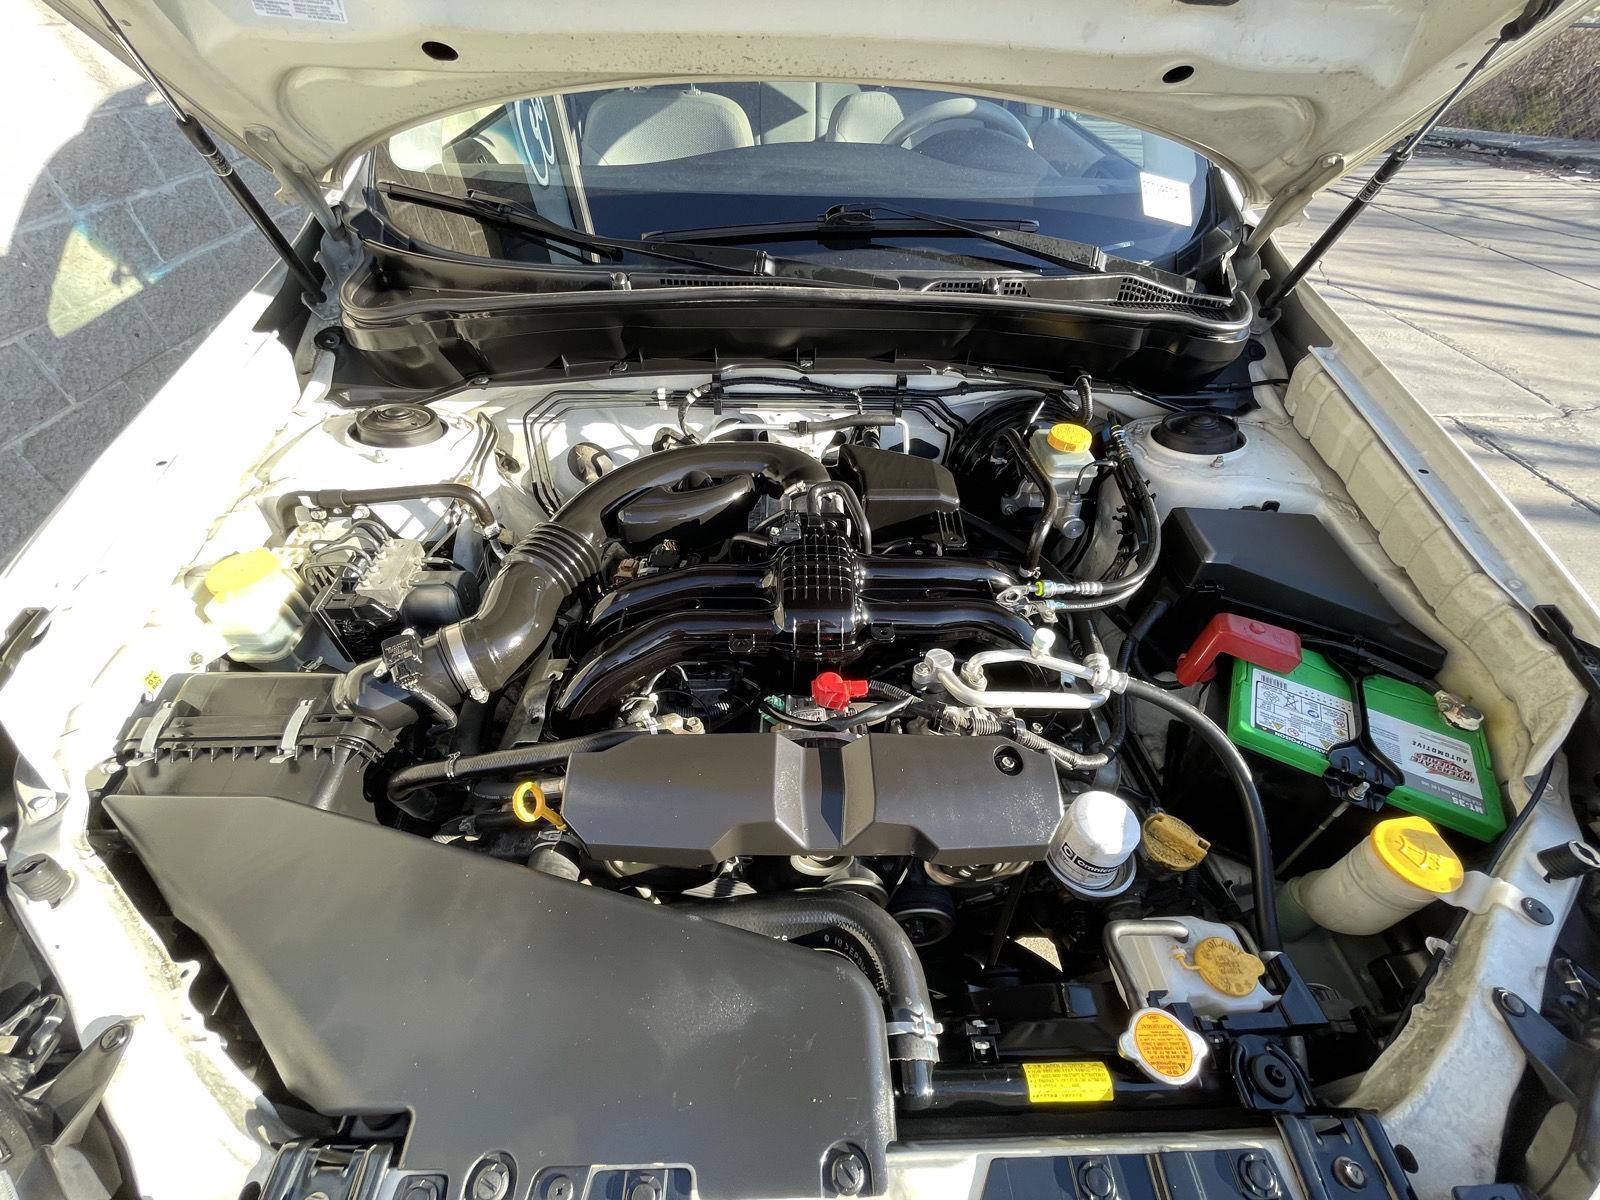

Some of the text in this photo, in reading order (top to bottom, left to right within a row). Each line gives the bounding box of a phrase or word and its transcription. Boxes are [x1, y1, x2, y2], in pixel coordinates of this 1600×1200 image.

[1274, 732, 1328, 754] ANGER/POISON
[1411, 740, 1468, 764] AUTOMOTIVE
[1409, 757, 1475, 784] INTERSTATE
[1413, 752, 1472, 776] BATTERIES
[1451, 796, 1484, 815] MT-35
